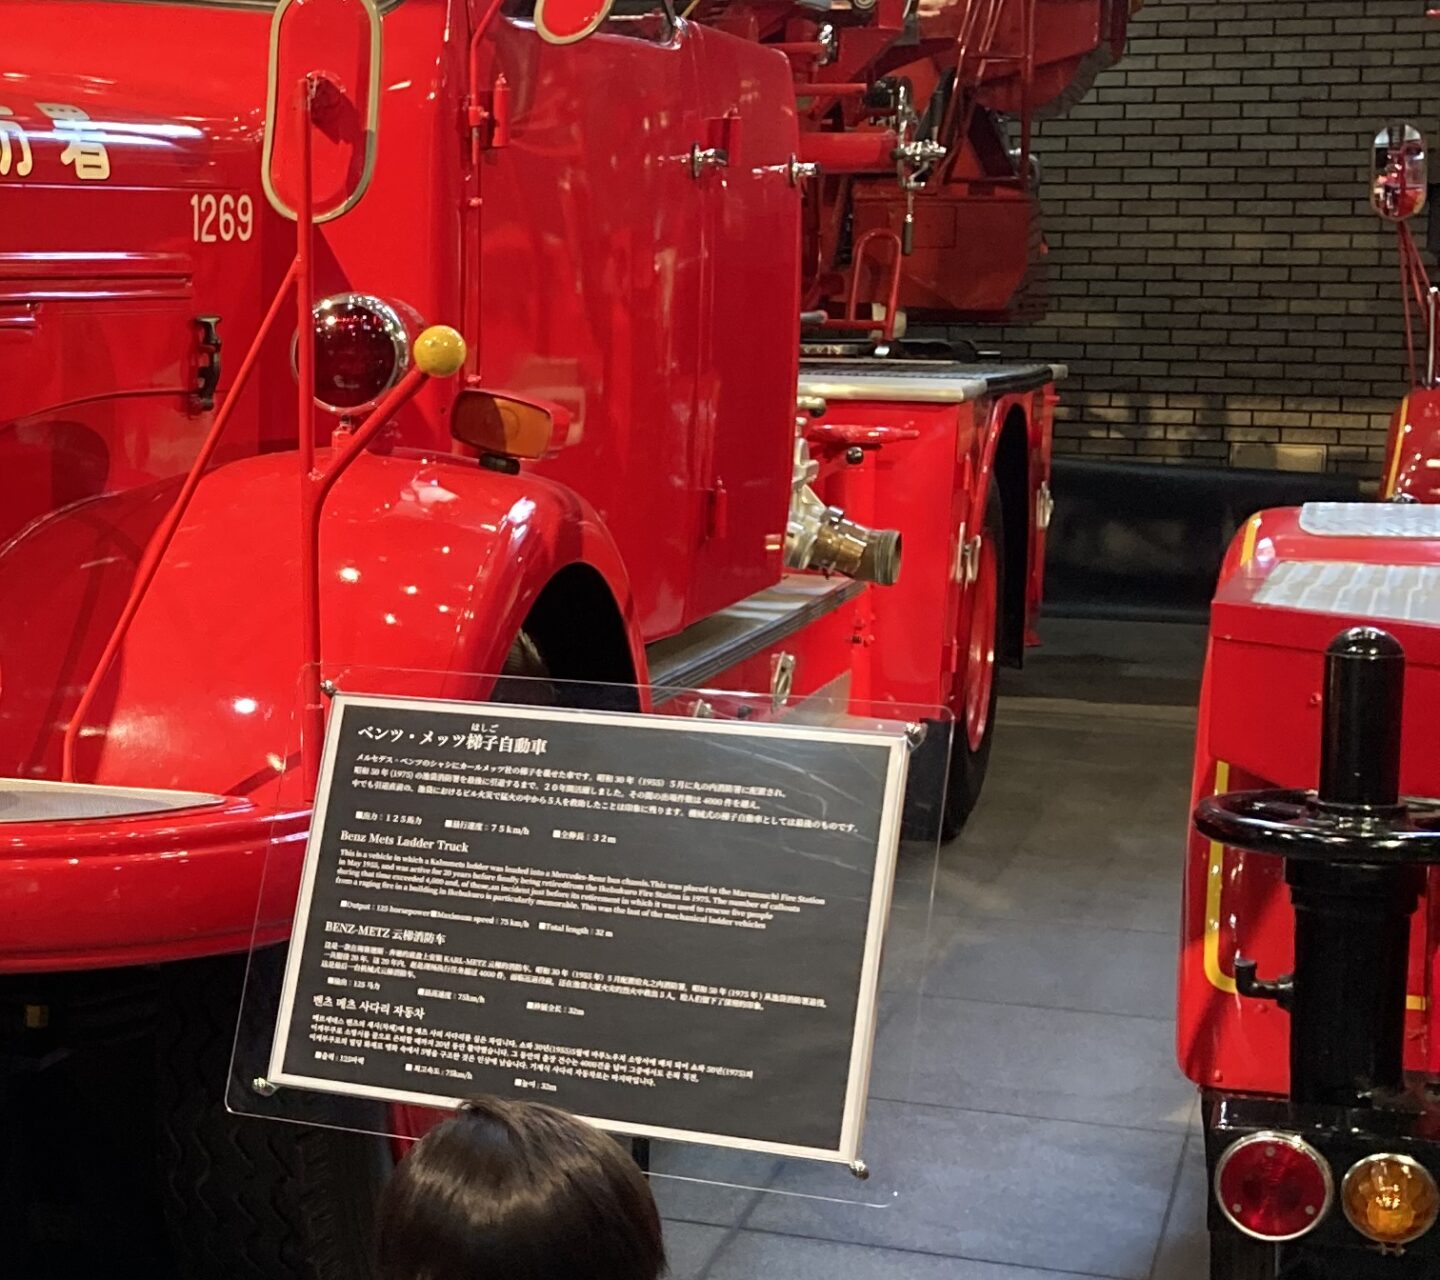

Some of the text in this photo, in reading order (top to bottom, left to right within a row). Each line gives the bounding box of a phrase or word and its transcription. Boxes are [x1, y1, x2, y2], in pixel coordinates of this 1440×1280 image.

[191, 194, 253, 243] 1269
[469, 722, 498, 733] はしご
[339, 831, 469, 852] Benz Mets Ladder Truck
[324, 921, 390, 938] BENZ-METZ
[312, 994, 424, 1019] 벤츠 메츠 사다리 자동차
